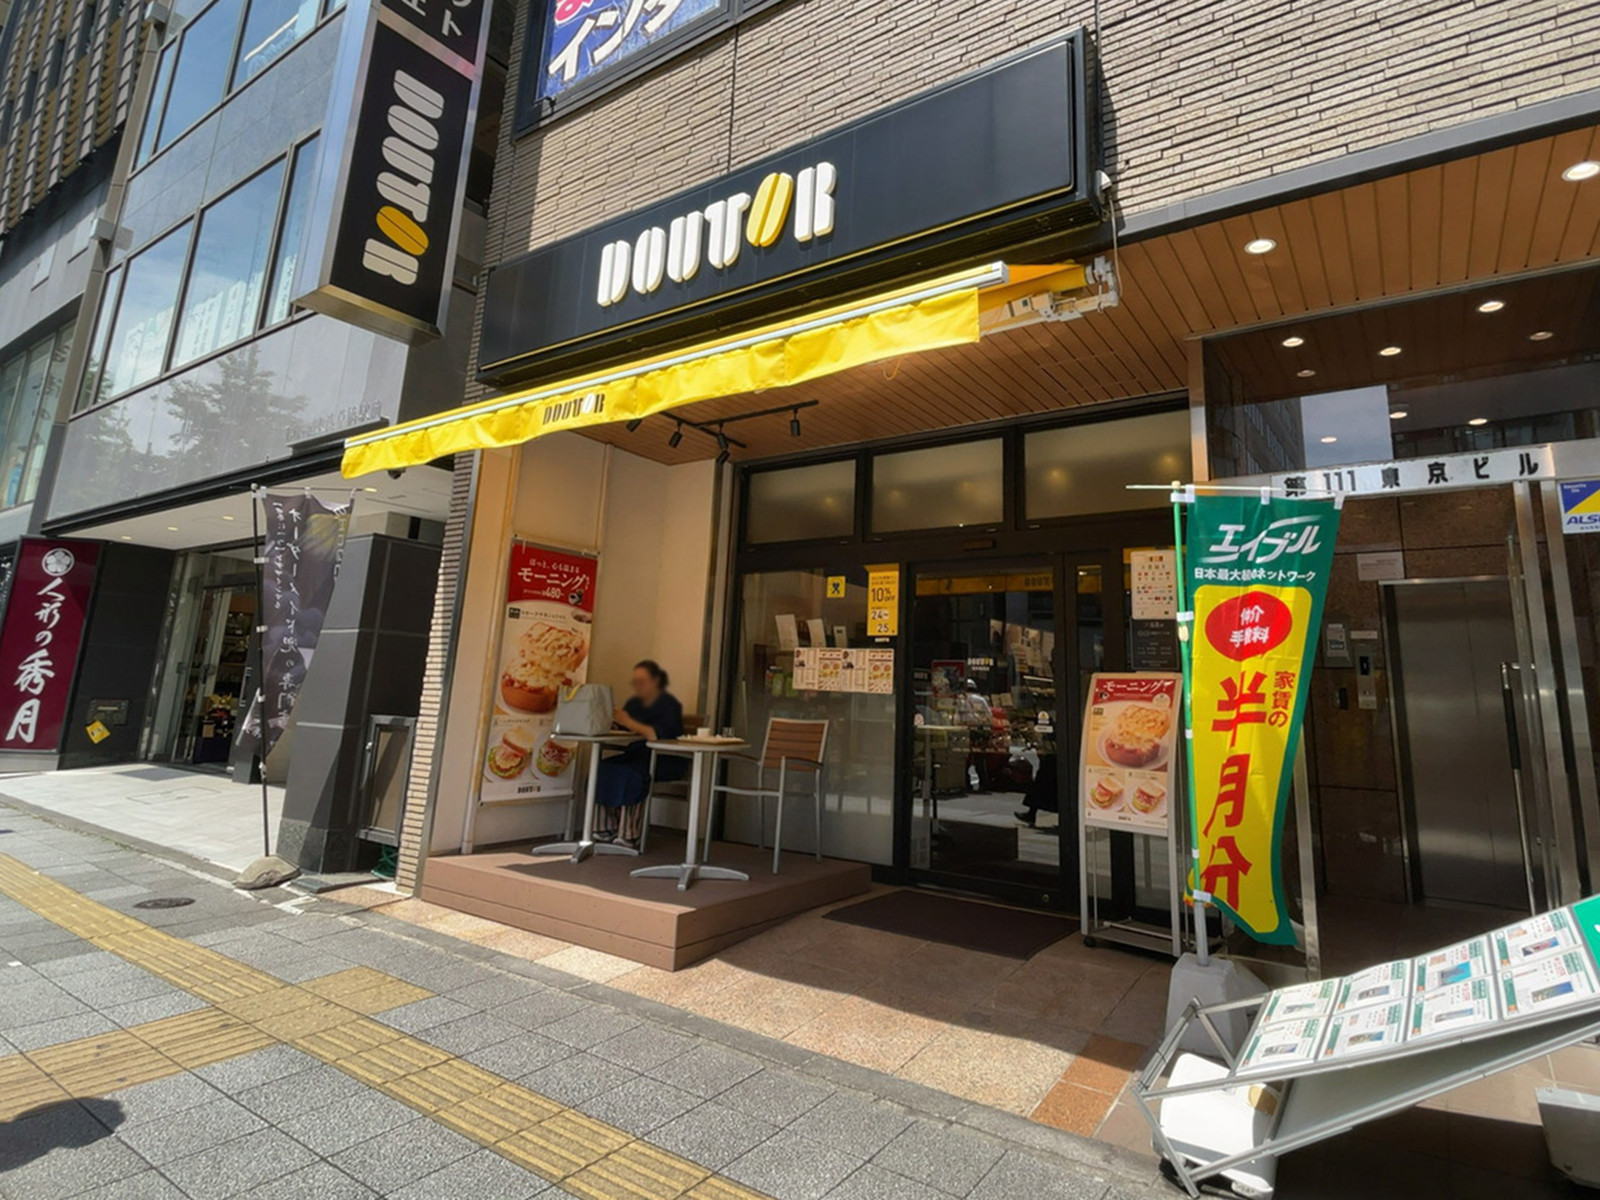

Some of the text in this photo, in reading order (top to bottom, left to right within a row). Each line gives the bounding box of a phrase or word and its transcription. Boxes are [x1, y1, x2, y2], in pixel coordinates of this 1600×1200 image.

[363, 69, 445, 285] DOUTOR
[596, 161, 837, 308] DOUTOR
[541, 393, 605, 426] DOUTOR
[1203, 516, 1323, 564] エイブル
[517, 566, 585, 591] モーニング
[4, 576, 66, 743] 人形の秀月
[1102, 679, 1162, 694] モーニング
[1268, 670, 1296, 728] 家賃の
[1200, 670, 1268, 912] 半月分
